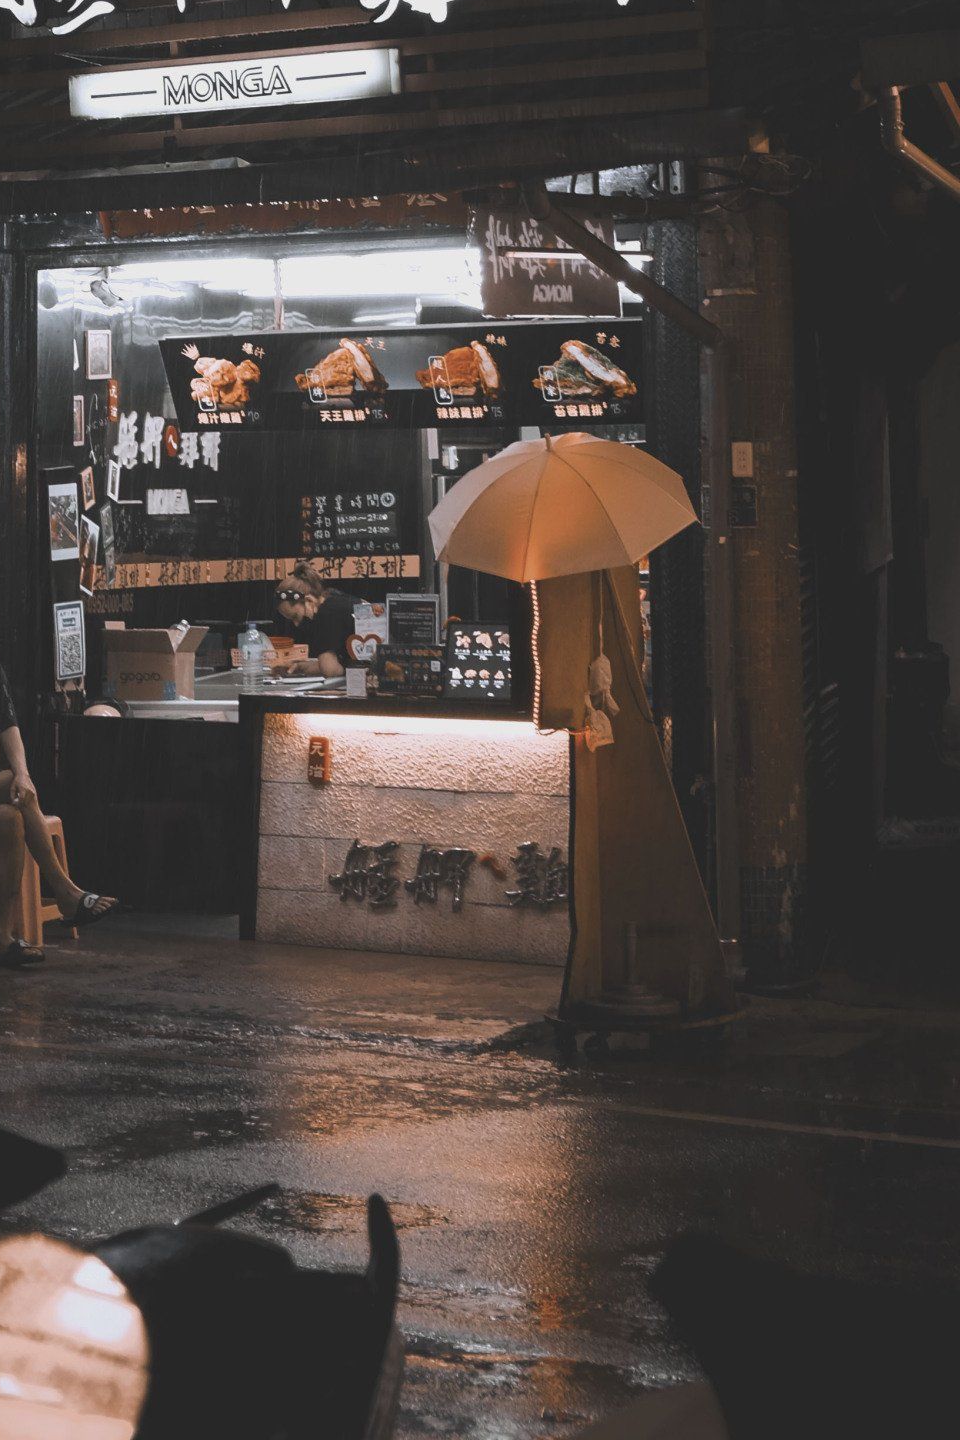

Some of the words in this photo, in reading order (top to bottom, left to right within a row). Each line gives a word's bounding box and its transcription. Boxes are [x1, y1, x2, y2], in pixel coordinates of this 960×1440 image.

[163, 64, 292, 106] MONGA
[365, 336, 387, 351] 天王
[120, 672, 161, 683] gogoro
